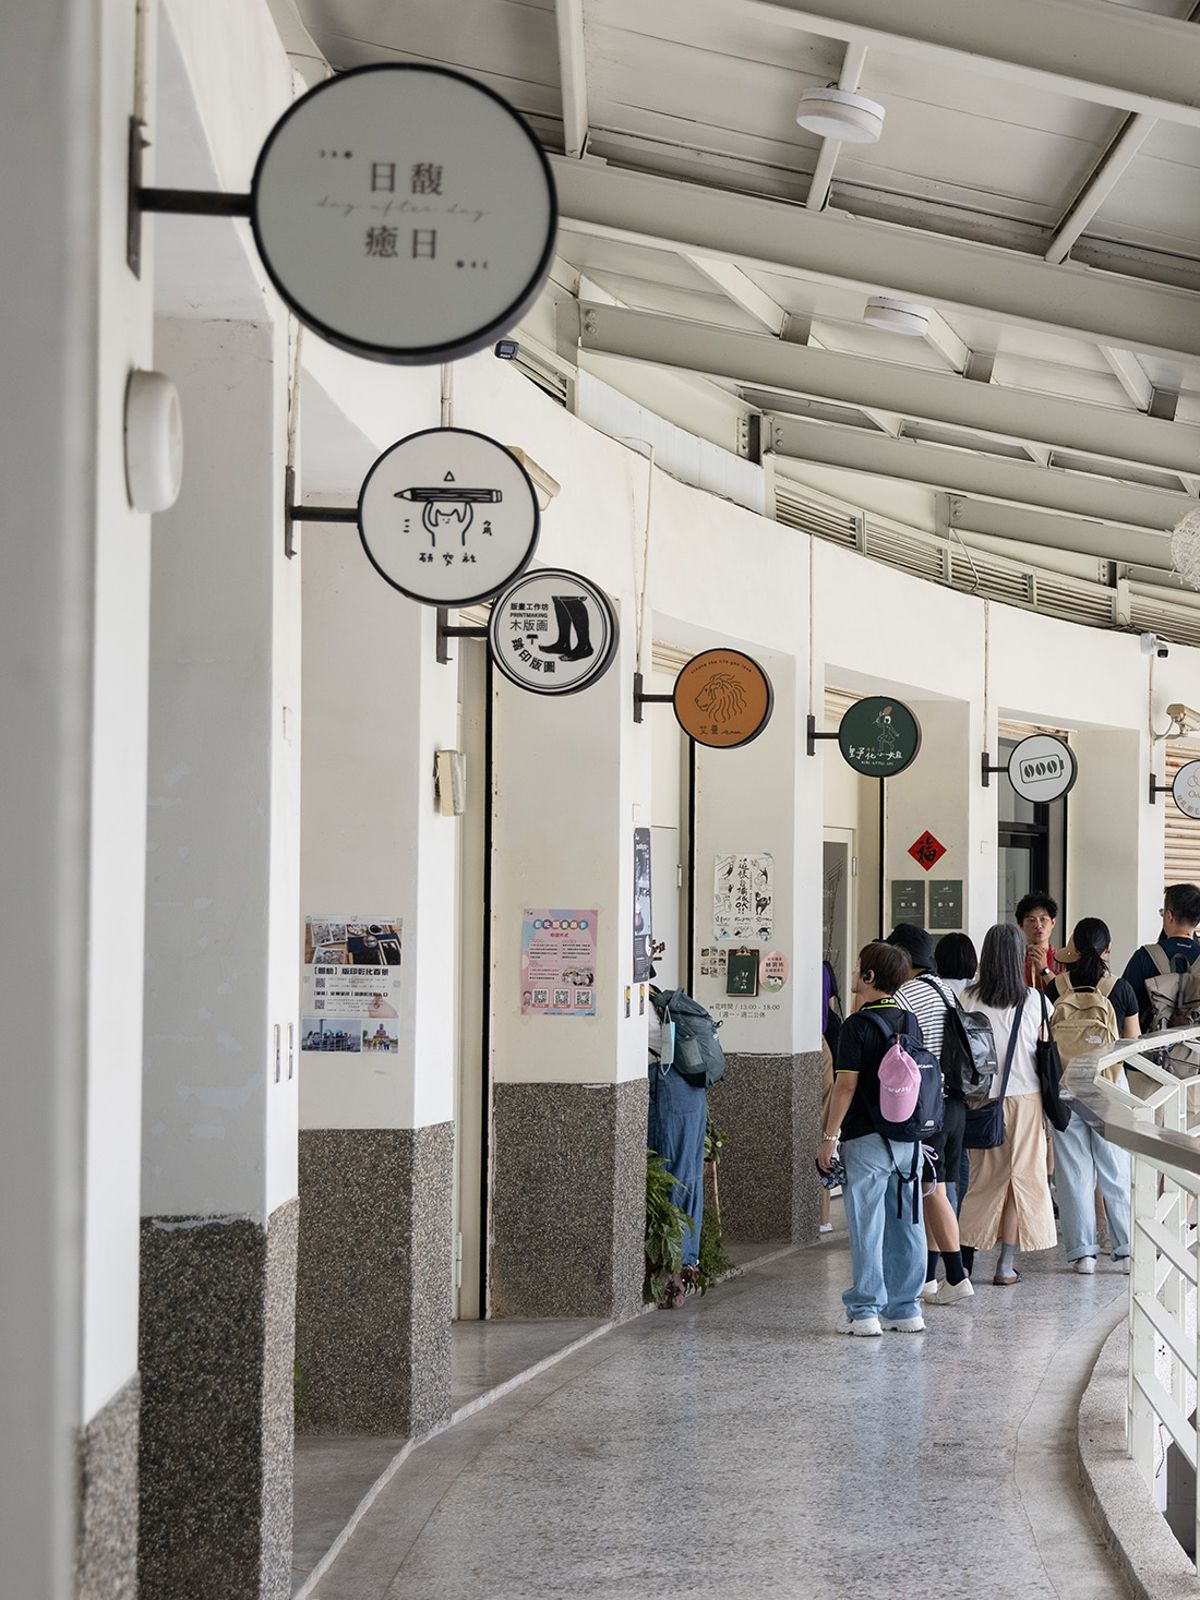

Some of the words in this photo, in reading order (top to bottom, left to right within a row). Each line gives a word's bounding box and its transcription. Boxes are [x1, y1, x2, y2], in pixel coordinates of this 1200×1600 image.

[370, 161, 444, 196] 日馥
[365, 225, 438, 259] 癒日
[510, 602, 549, 611] 版畫工作坊
[509, 619, 548, 632] 木版画
[916, 836, 937, 864] 福
